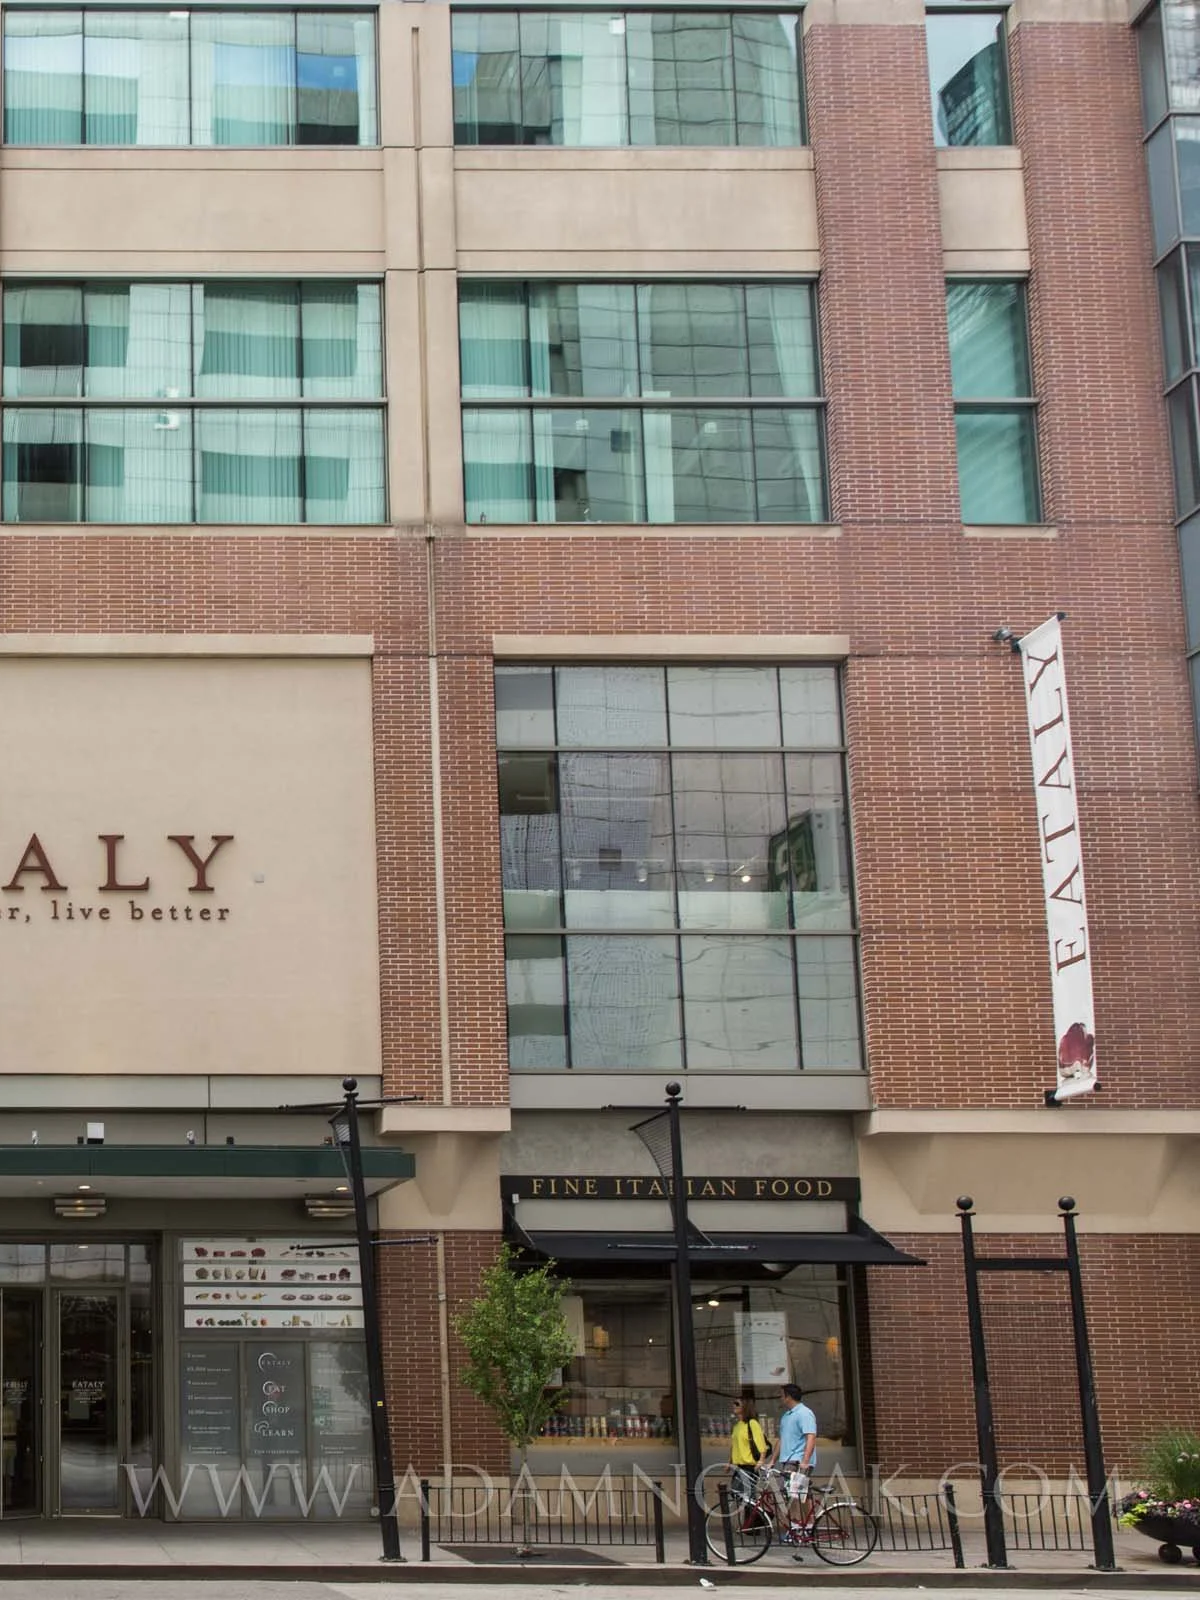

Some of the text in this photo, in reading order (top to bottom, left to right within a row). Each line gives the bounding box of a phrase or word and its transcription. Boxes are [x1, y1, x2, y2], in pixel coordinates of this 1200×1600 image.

[1027, 645, 1086, 975] EATALY
[50, 899, 110, 921] live
[130, 899, 231, 921] better
[531, 1178, 598, 1196] FINE
[754, 1179, 833, 1197] FOOD
[266, 1406, 290, 1414] SHOP
[263, 1429, 294, 1437] LEARN
